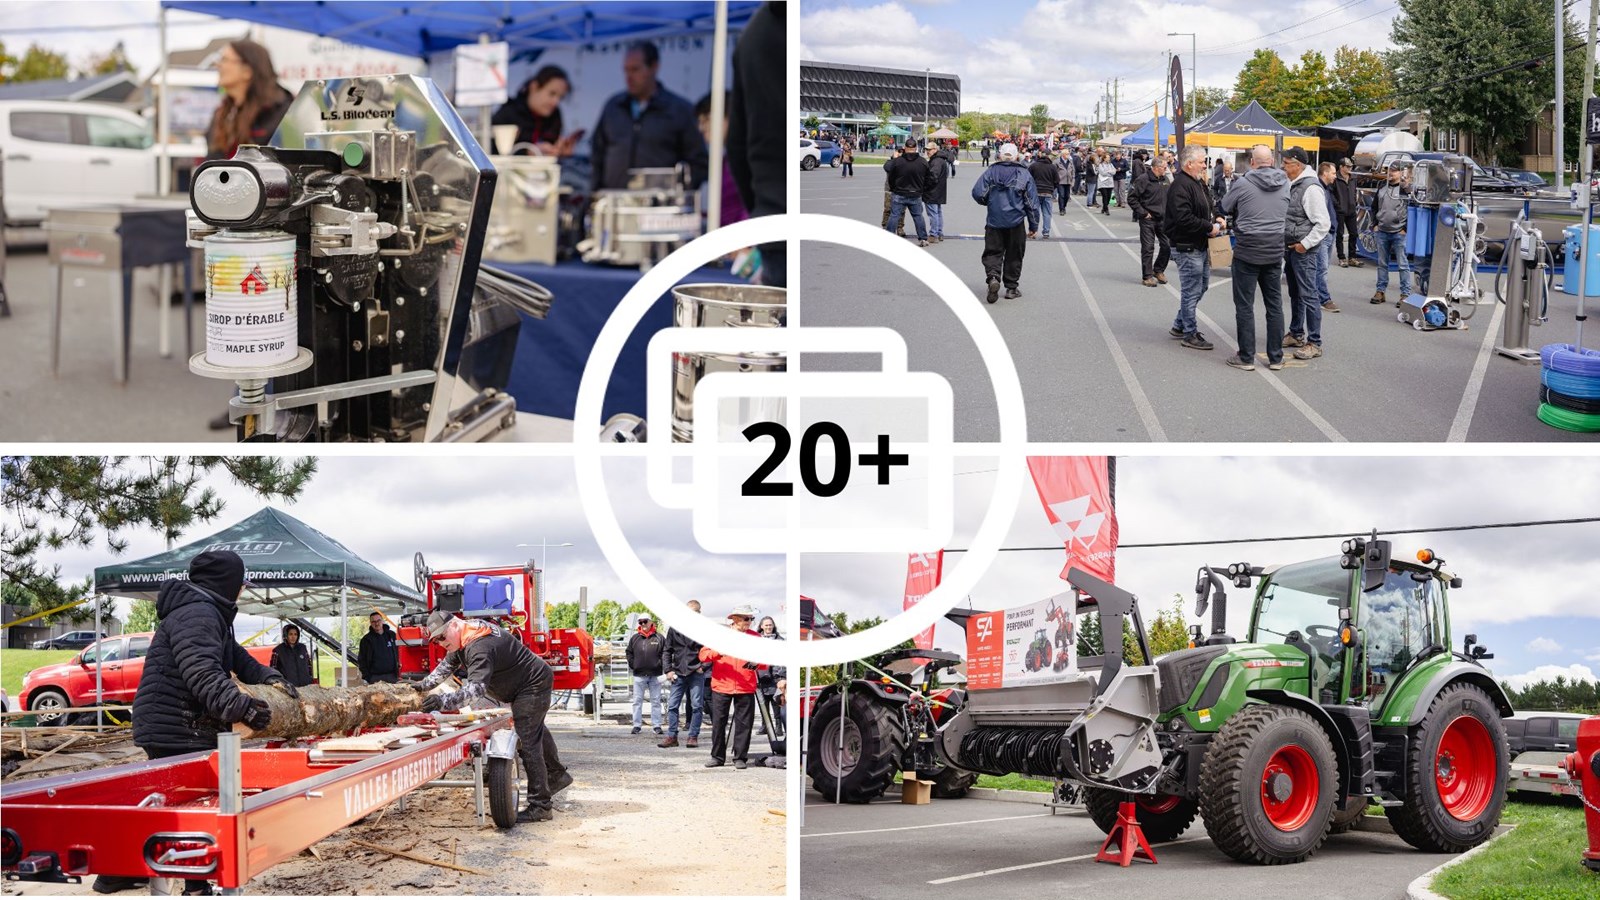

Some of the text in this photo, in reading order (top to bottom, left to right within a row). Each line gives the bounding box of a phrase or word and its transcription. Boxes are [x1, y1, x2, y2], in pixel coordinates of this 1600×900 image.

[321, 109, 395, 120] L.S. Bilodeau
[208, 312, 285, 325] SIROP D'ÉRABLE
[225, 344, 256, 353] MAPLE
[258, 341, 285, 352] SYRUP
[209, 543, 276, 552] VALLEE
[1006, 618, 1034, 632] PERFORMANT
[343, 772, 389, 818] VALLEE
[391, 755, 433, 796] FORESTRY
